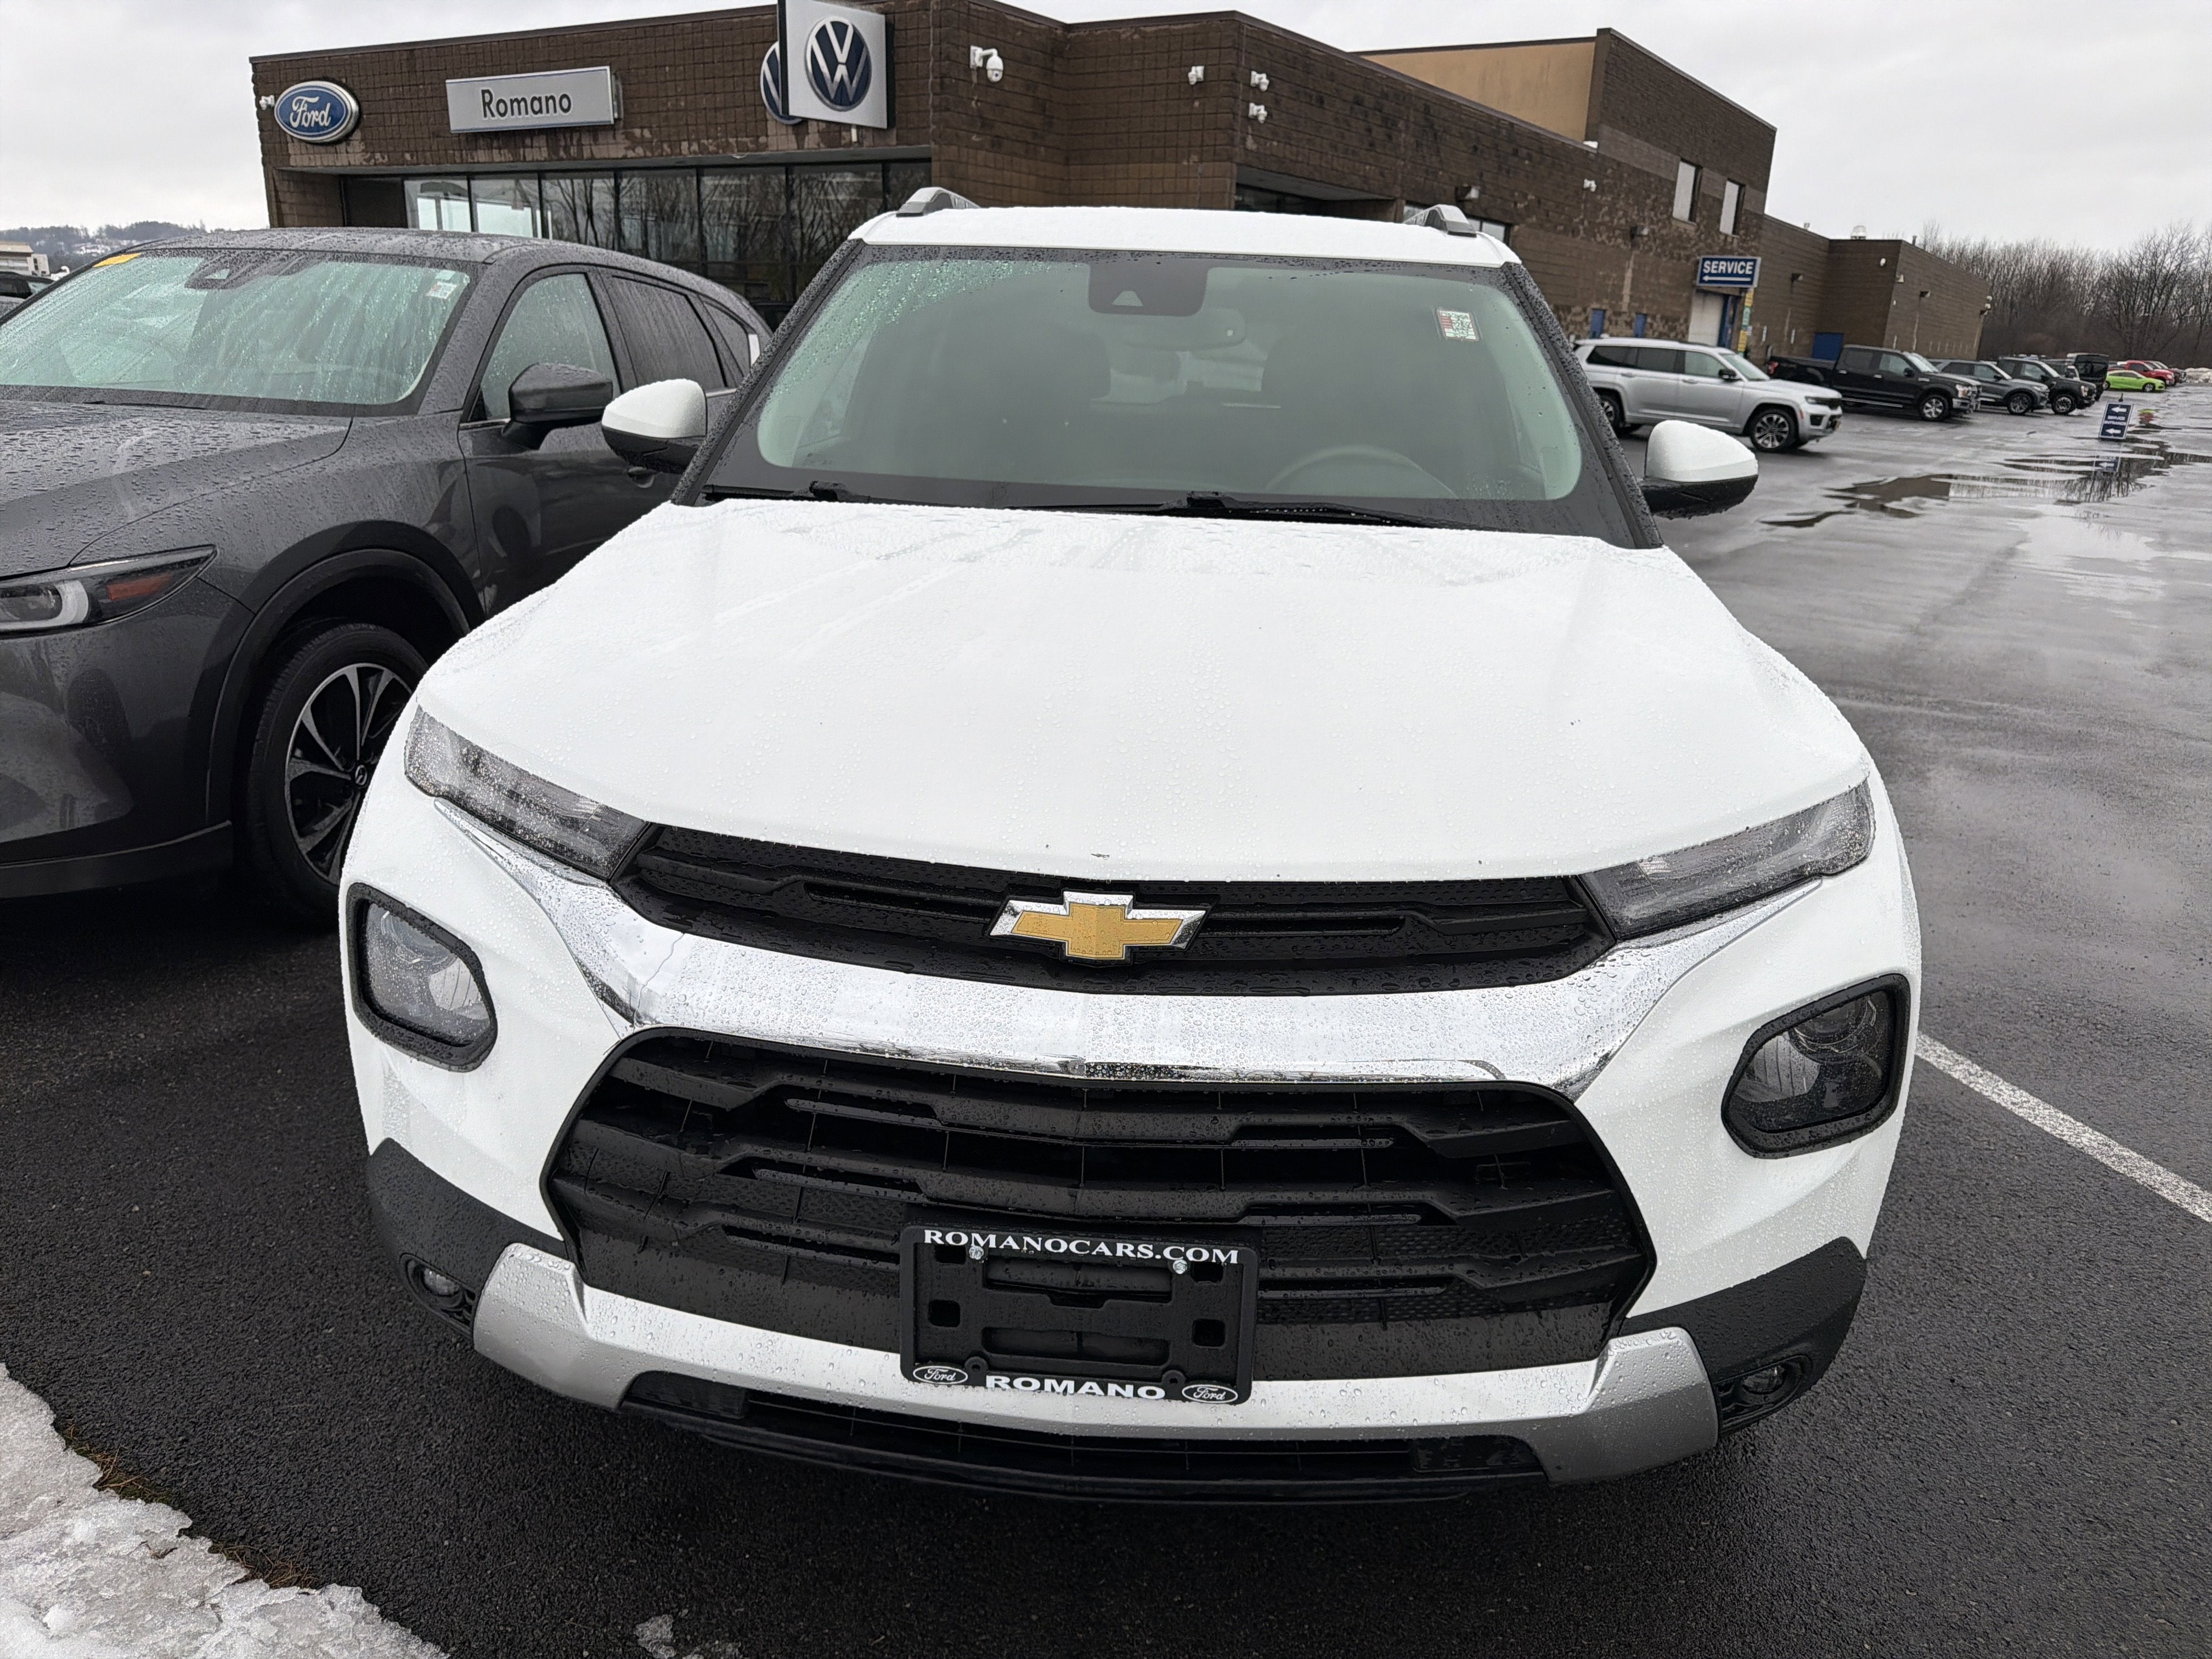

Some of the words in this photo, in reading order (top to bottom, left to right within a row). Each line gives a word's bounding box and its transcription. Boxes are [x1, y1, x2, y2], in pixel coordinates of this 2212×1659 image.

[290, 95, 331, 128] Ford
[481, 89, 572, 119] Romano
[1702, 260, 1754, 274] SERVICE
[924, 1229, 1238, 1264] ROMANOCARS.COM
[924, 1368, 956, 1381] Ford
[986, 1375, 1165, 1400] ROMANO
[1193, 1386, 1227, 1400] Ford
